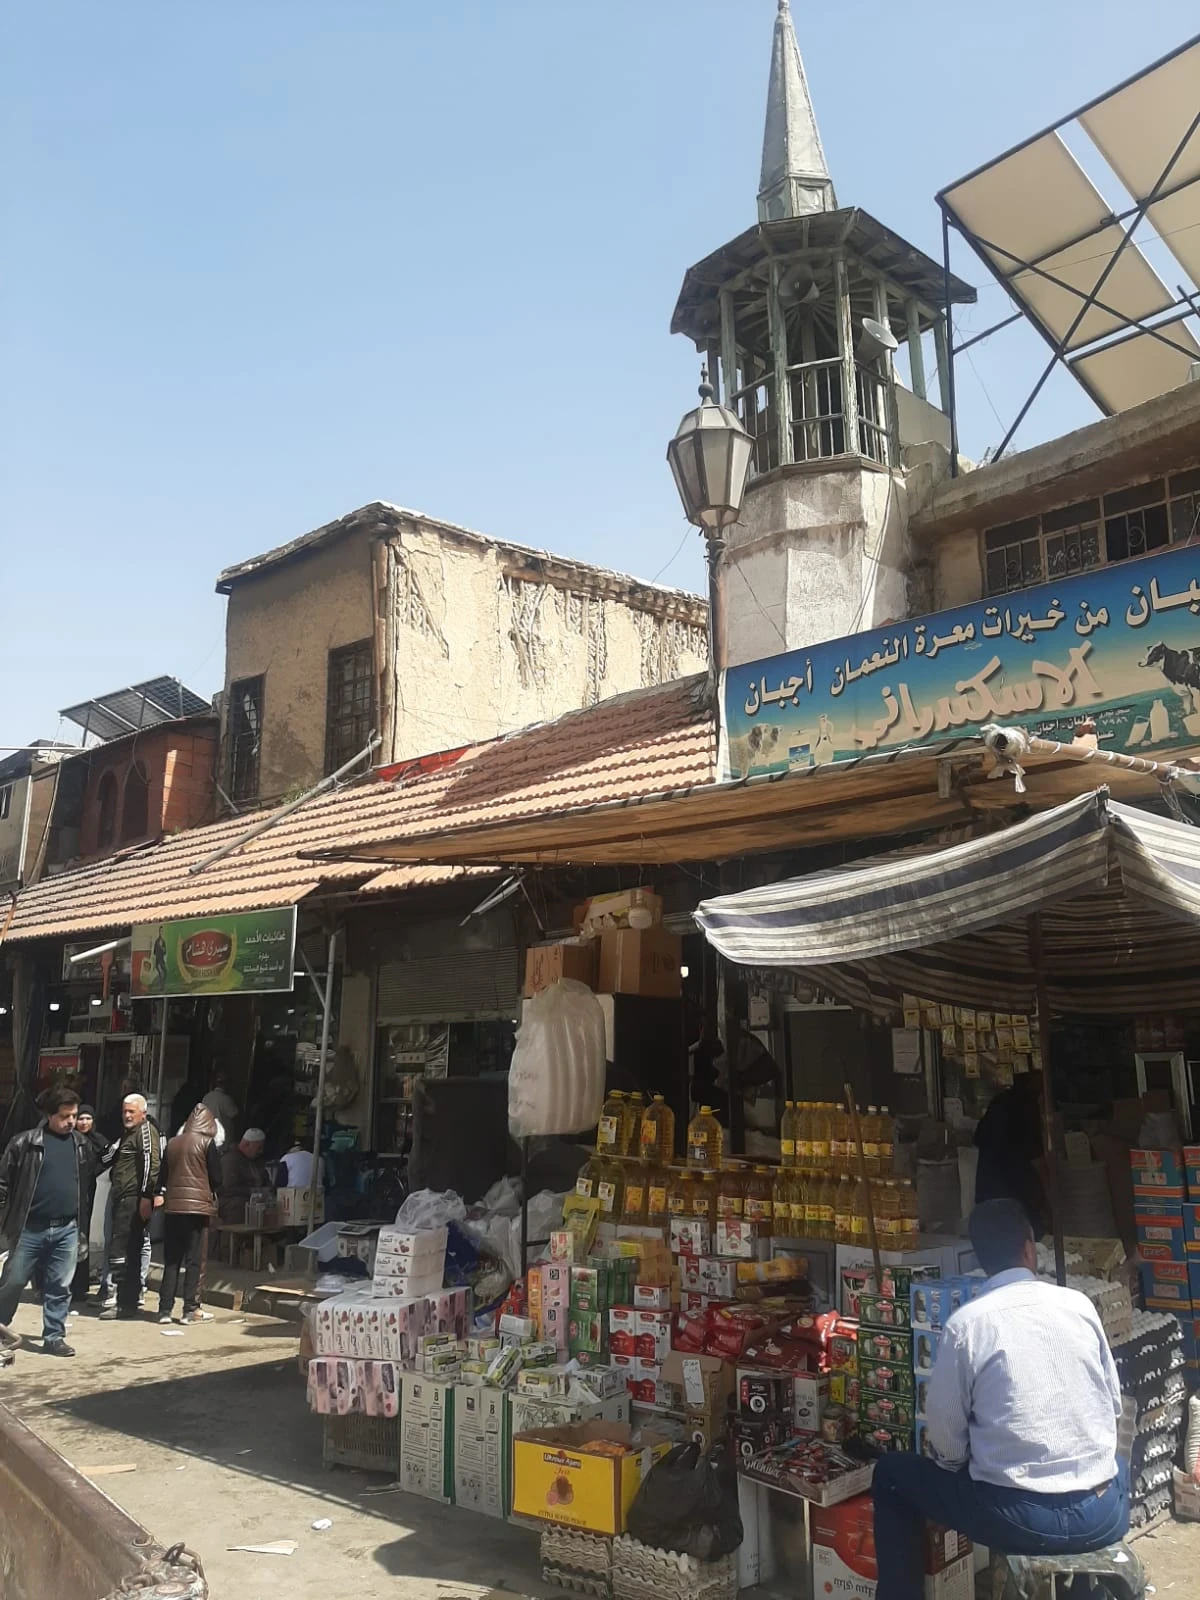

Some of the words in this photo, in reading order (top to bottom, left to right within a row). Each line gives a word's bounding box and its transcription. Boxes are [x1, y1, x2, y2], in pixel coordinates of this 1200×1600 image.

[982, 599, 1065, 641] خيرات
[1075, 600, 1109, 634] من
[914, 622, 975, 657] معرة
[831, 634, 908, 695] النعمان
[744, 658, 813, 715] أجبان
